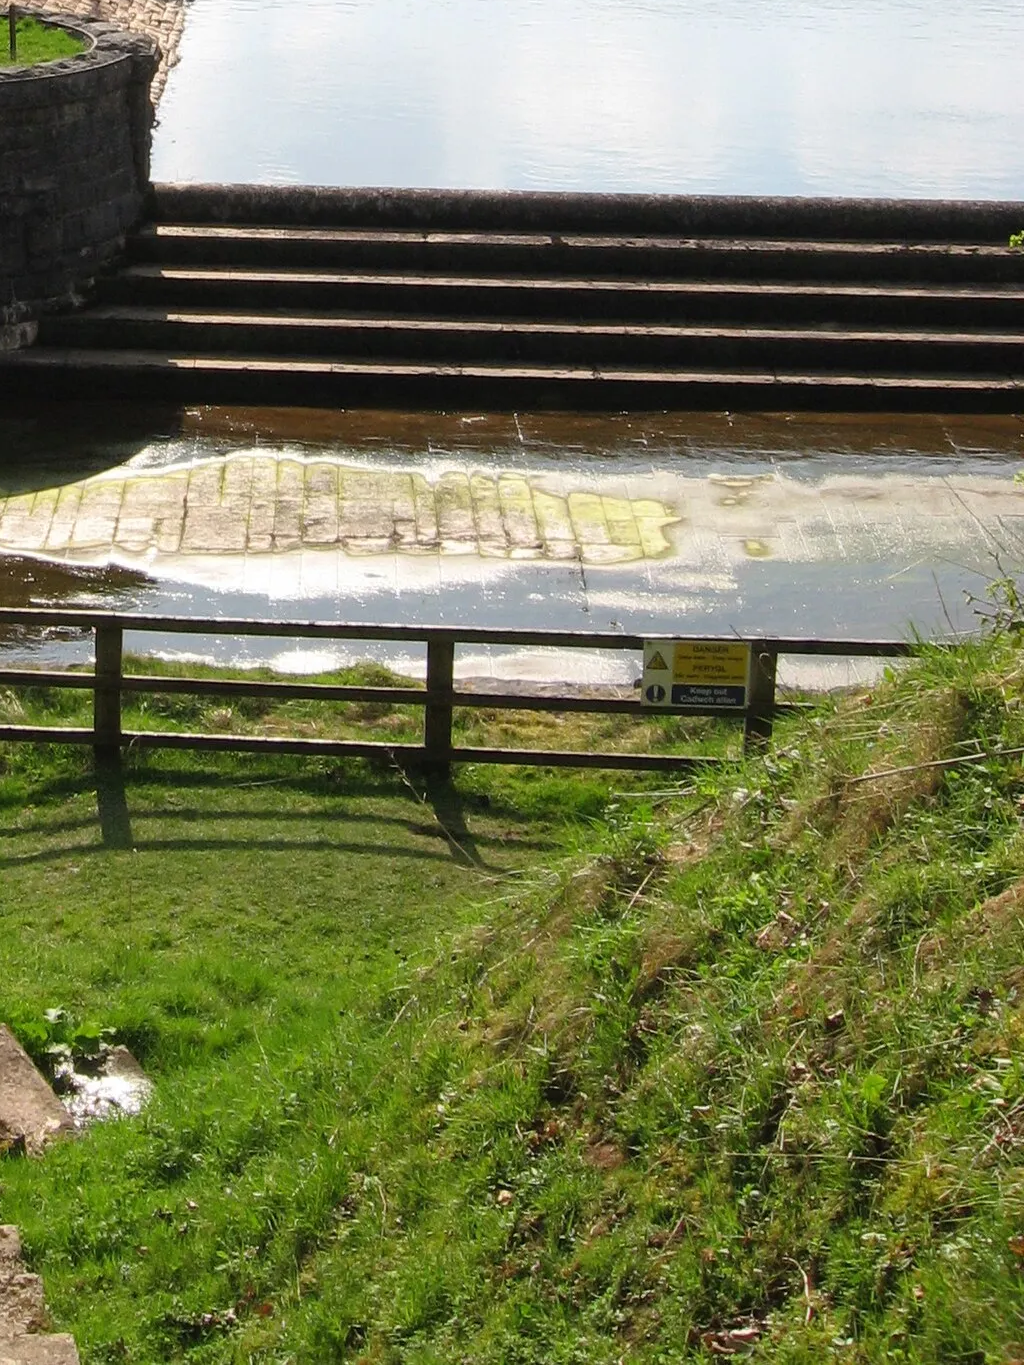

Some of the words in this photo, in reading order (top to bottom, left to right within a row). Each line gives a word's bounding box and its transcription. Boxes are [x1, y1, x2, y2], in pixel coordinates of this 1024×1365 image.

[693, 645, 729, 653] DANGER
[690, 687, 712, 696] Keep
[713, 688, 728, 696] out
[680, 695, 714, 704] Cadwch
